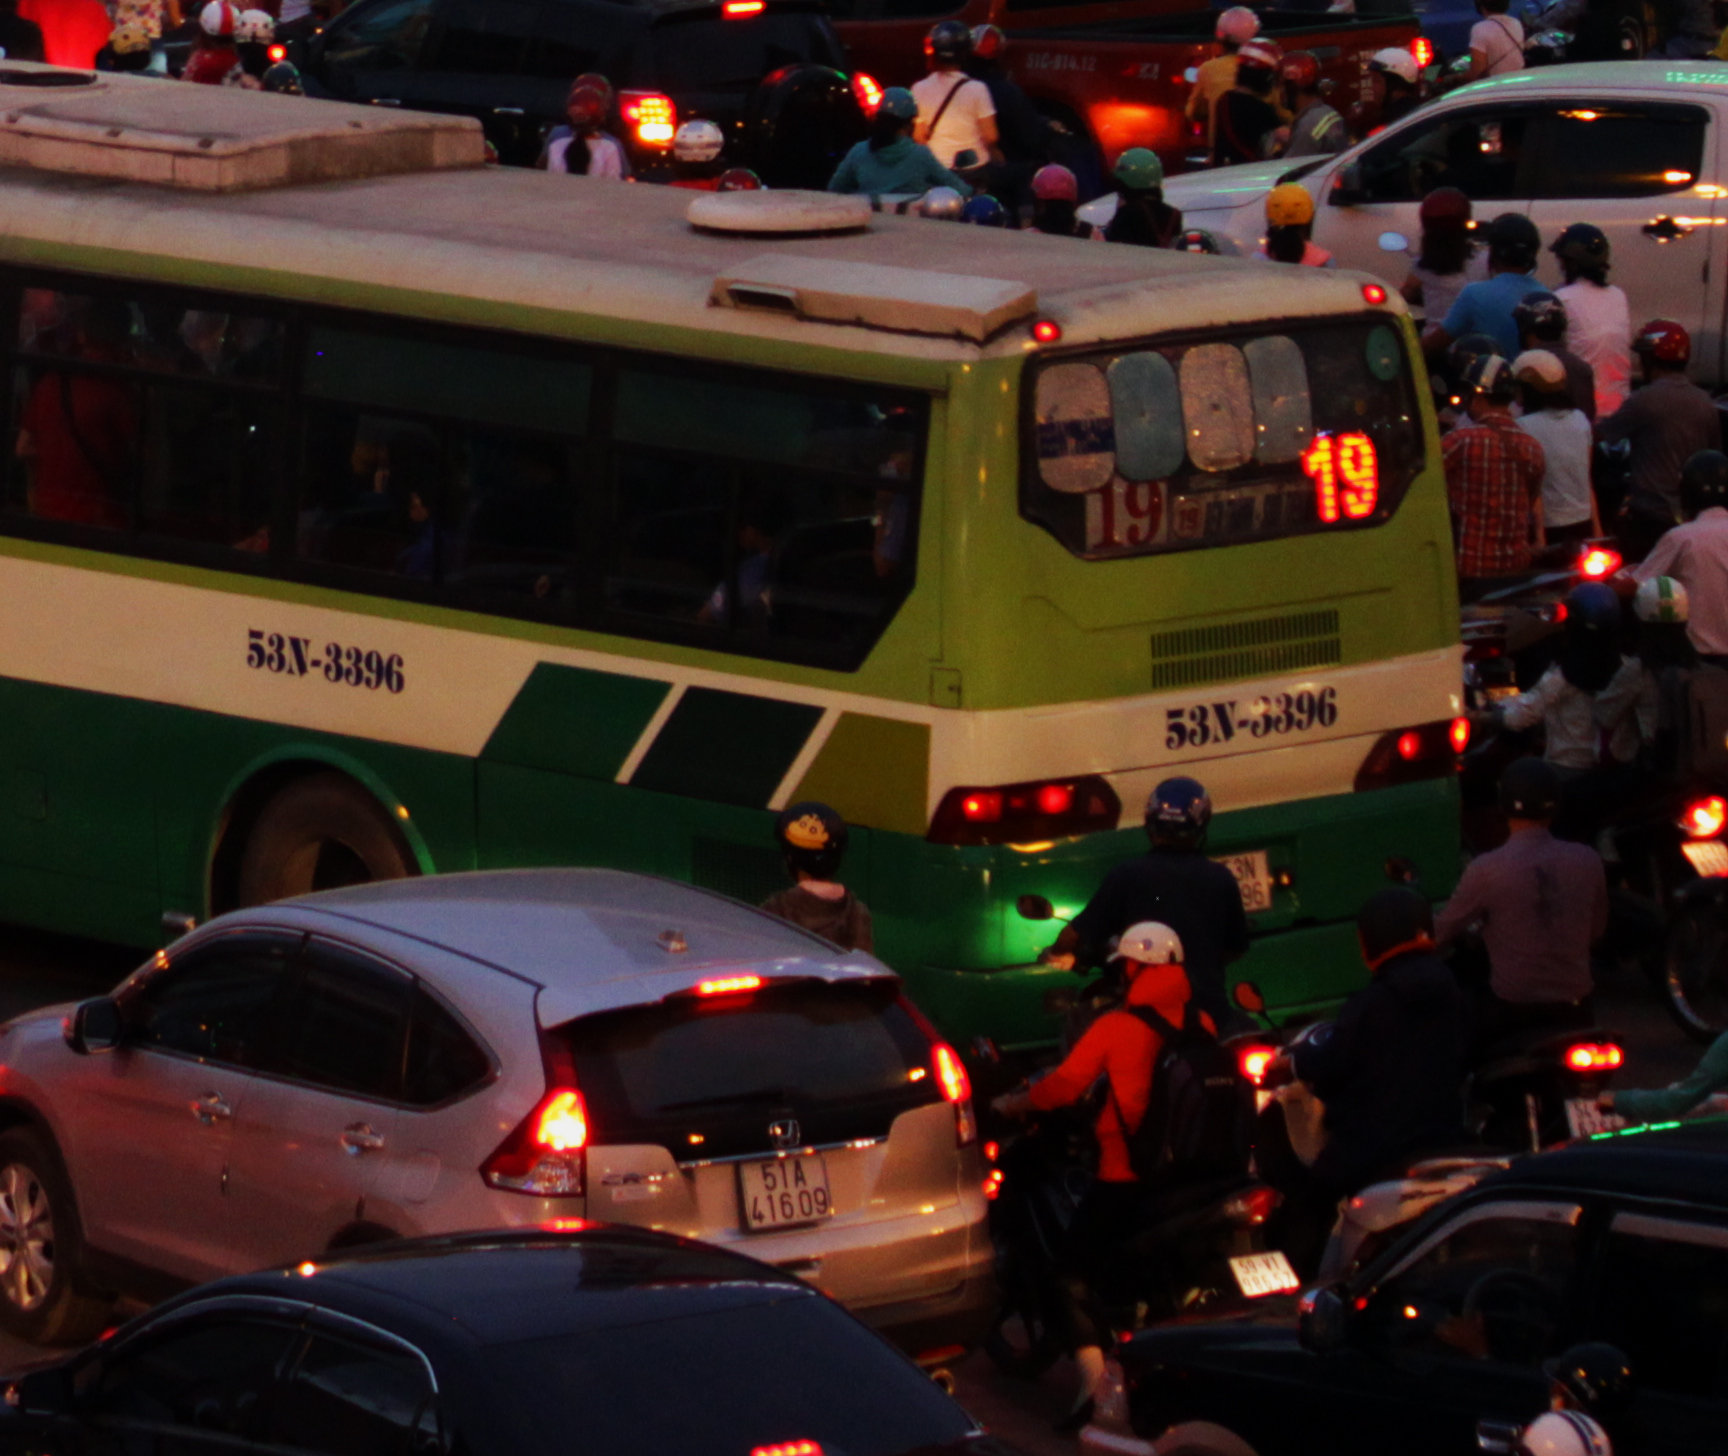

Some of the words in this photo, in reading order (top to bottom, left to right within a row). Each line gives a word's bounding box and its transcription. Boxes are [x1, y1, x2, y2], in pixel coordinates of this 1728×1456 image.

[1300, 430, 1379, 523] 19
[1090, 480, 1166, 547] 19
[247, 627, 405, 695] 53N-3396
[1164, 686, 1338, 751] 53N-3396
[751, 1187, 830, 1225] 416.09
[759, 1160, 808, 1190] 51A
